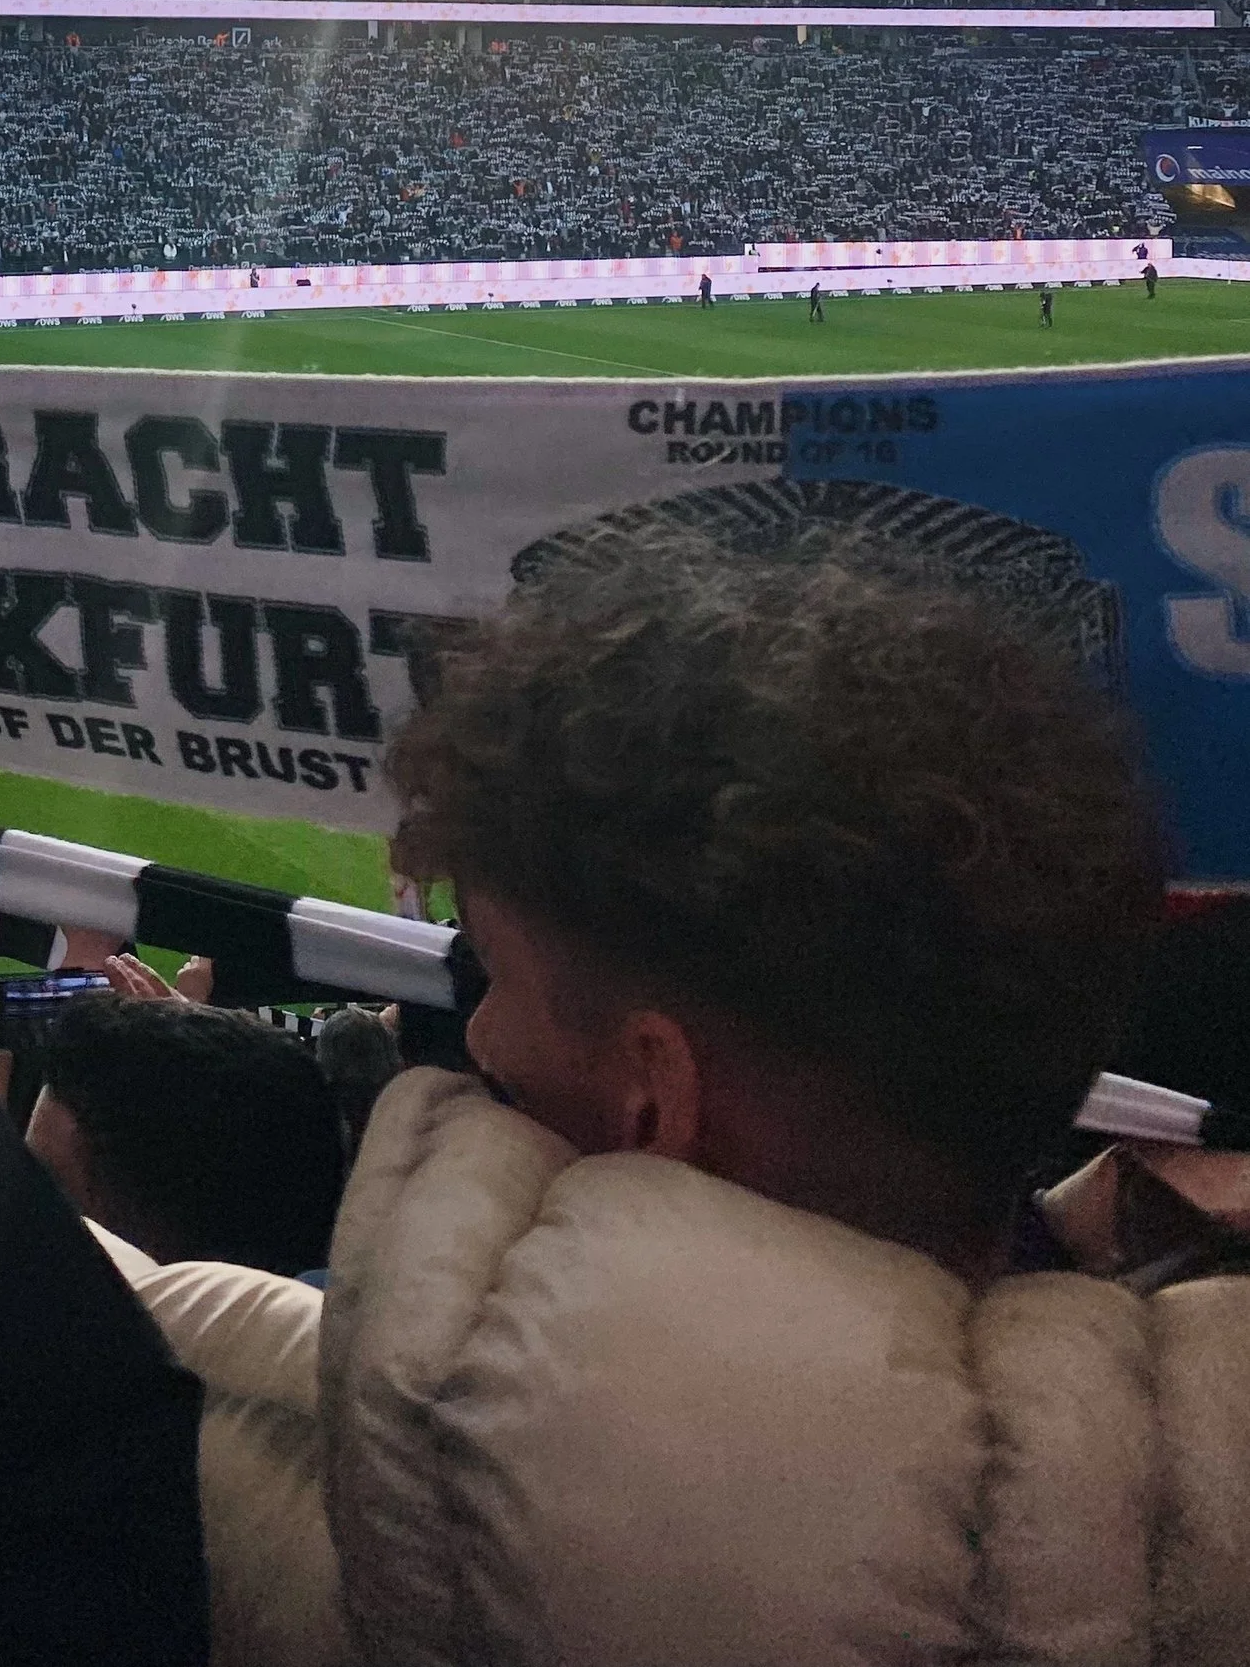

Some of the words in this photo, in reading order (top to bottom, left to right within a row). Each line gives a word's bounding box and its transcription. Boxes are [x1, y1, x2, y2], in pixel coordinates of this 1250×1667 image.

[627, 396, 938, 436] CHAMPIONS
[666, 440, 788, 465] ROUND
[800, 440, 847, 465] OF
[856, 440, 898, 465] 16
[48, 712, 164, 767] DER
[177, 730, 371, 794] BRUST
